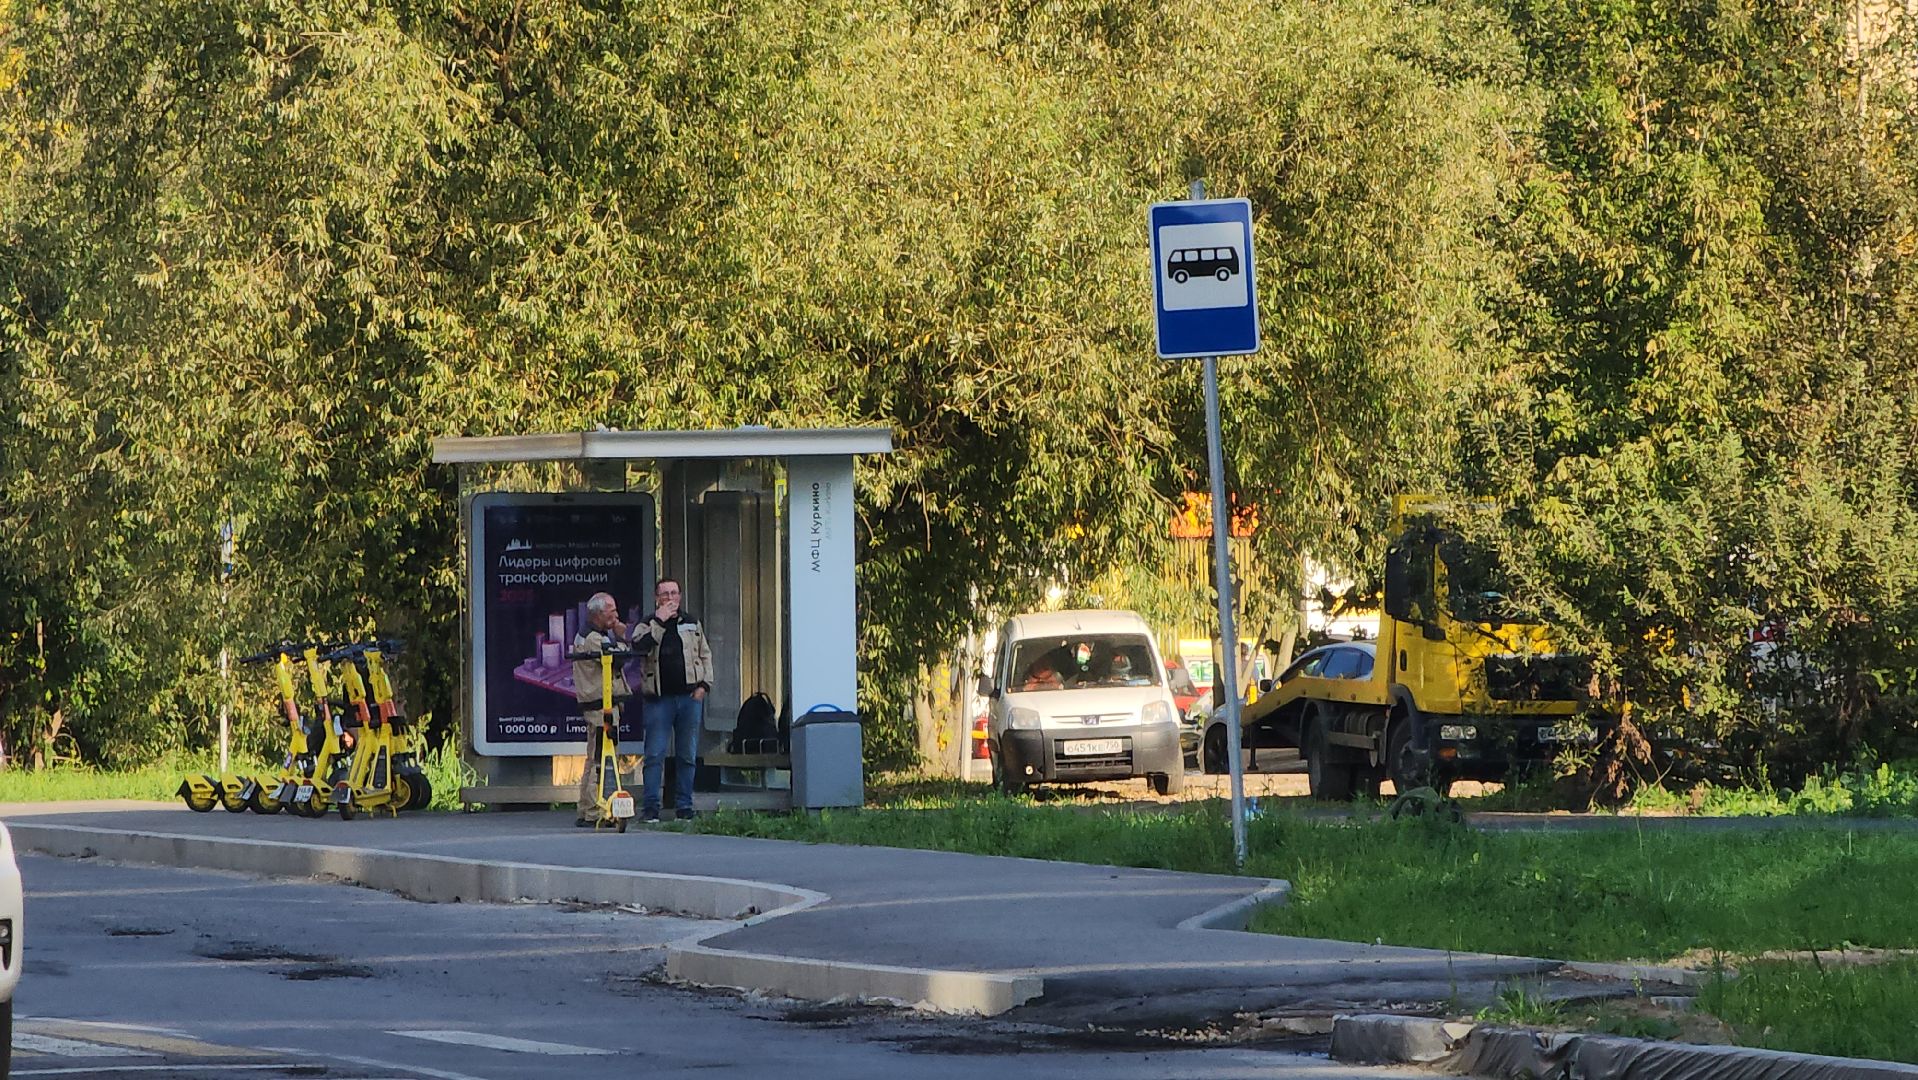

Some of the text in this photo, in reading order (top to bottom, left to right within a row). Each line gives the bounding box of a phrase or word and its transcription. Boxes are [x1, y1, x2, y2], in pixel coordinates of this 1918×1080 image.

[811, 482, 822, 573] МФЦ Куркино
[499, 554, 621, 570] Лидеры цифровой
[498, 572, 608, 586] трансформации
[499, 725, 503, 734] 1
[505, 725, 525, 734] 000
[527, 725, 548, 734] 000
